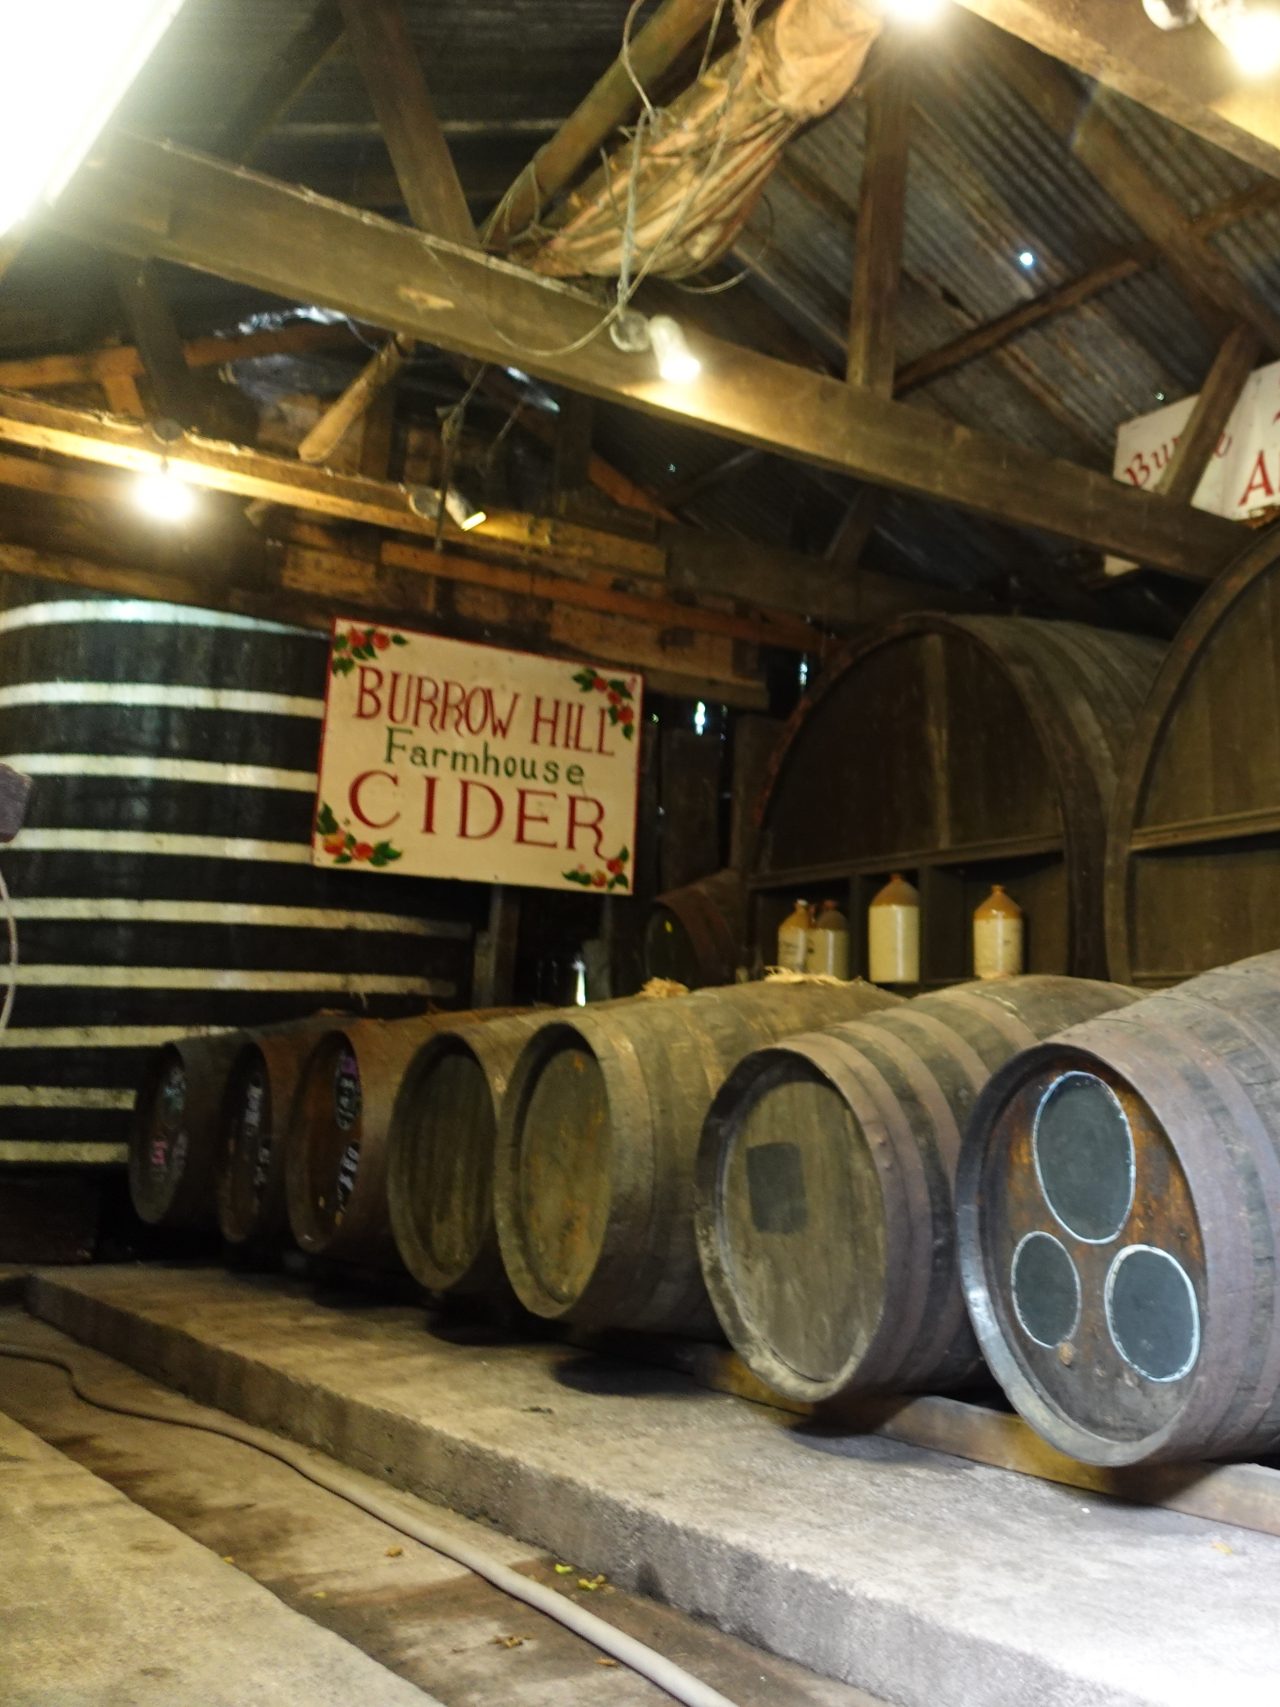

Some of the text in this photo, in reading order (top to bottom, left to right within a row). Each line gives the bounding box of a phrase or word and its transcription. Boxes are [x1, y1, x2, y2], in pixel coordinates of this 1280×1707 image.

[354, 665, 616, 757] BURROW HILL
[384, 726, 586, 786] Farmhouse
[348, 770, 611, 862] CIDER
